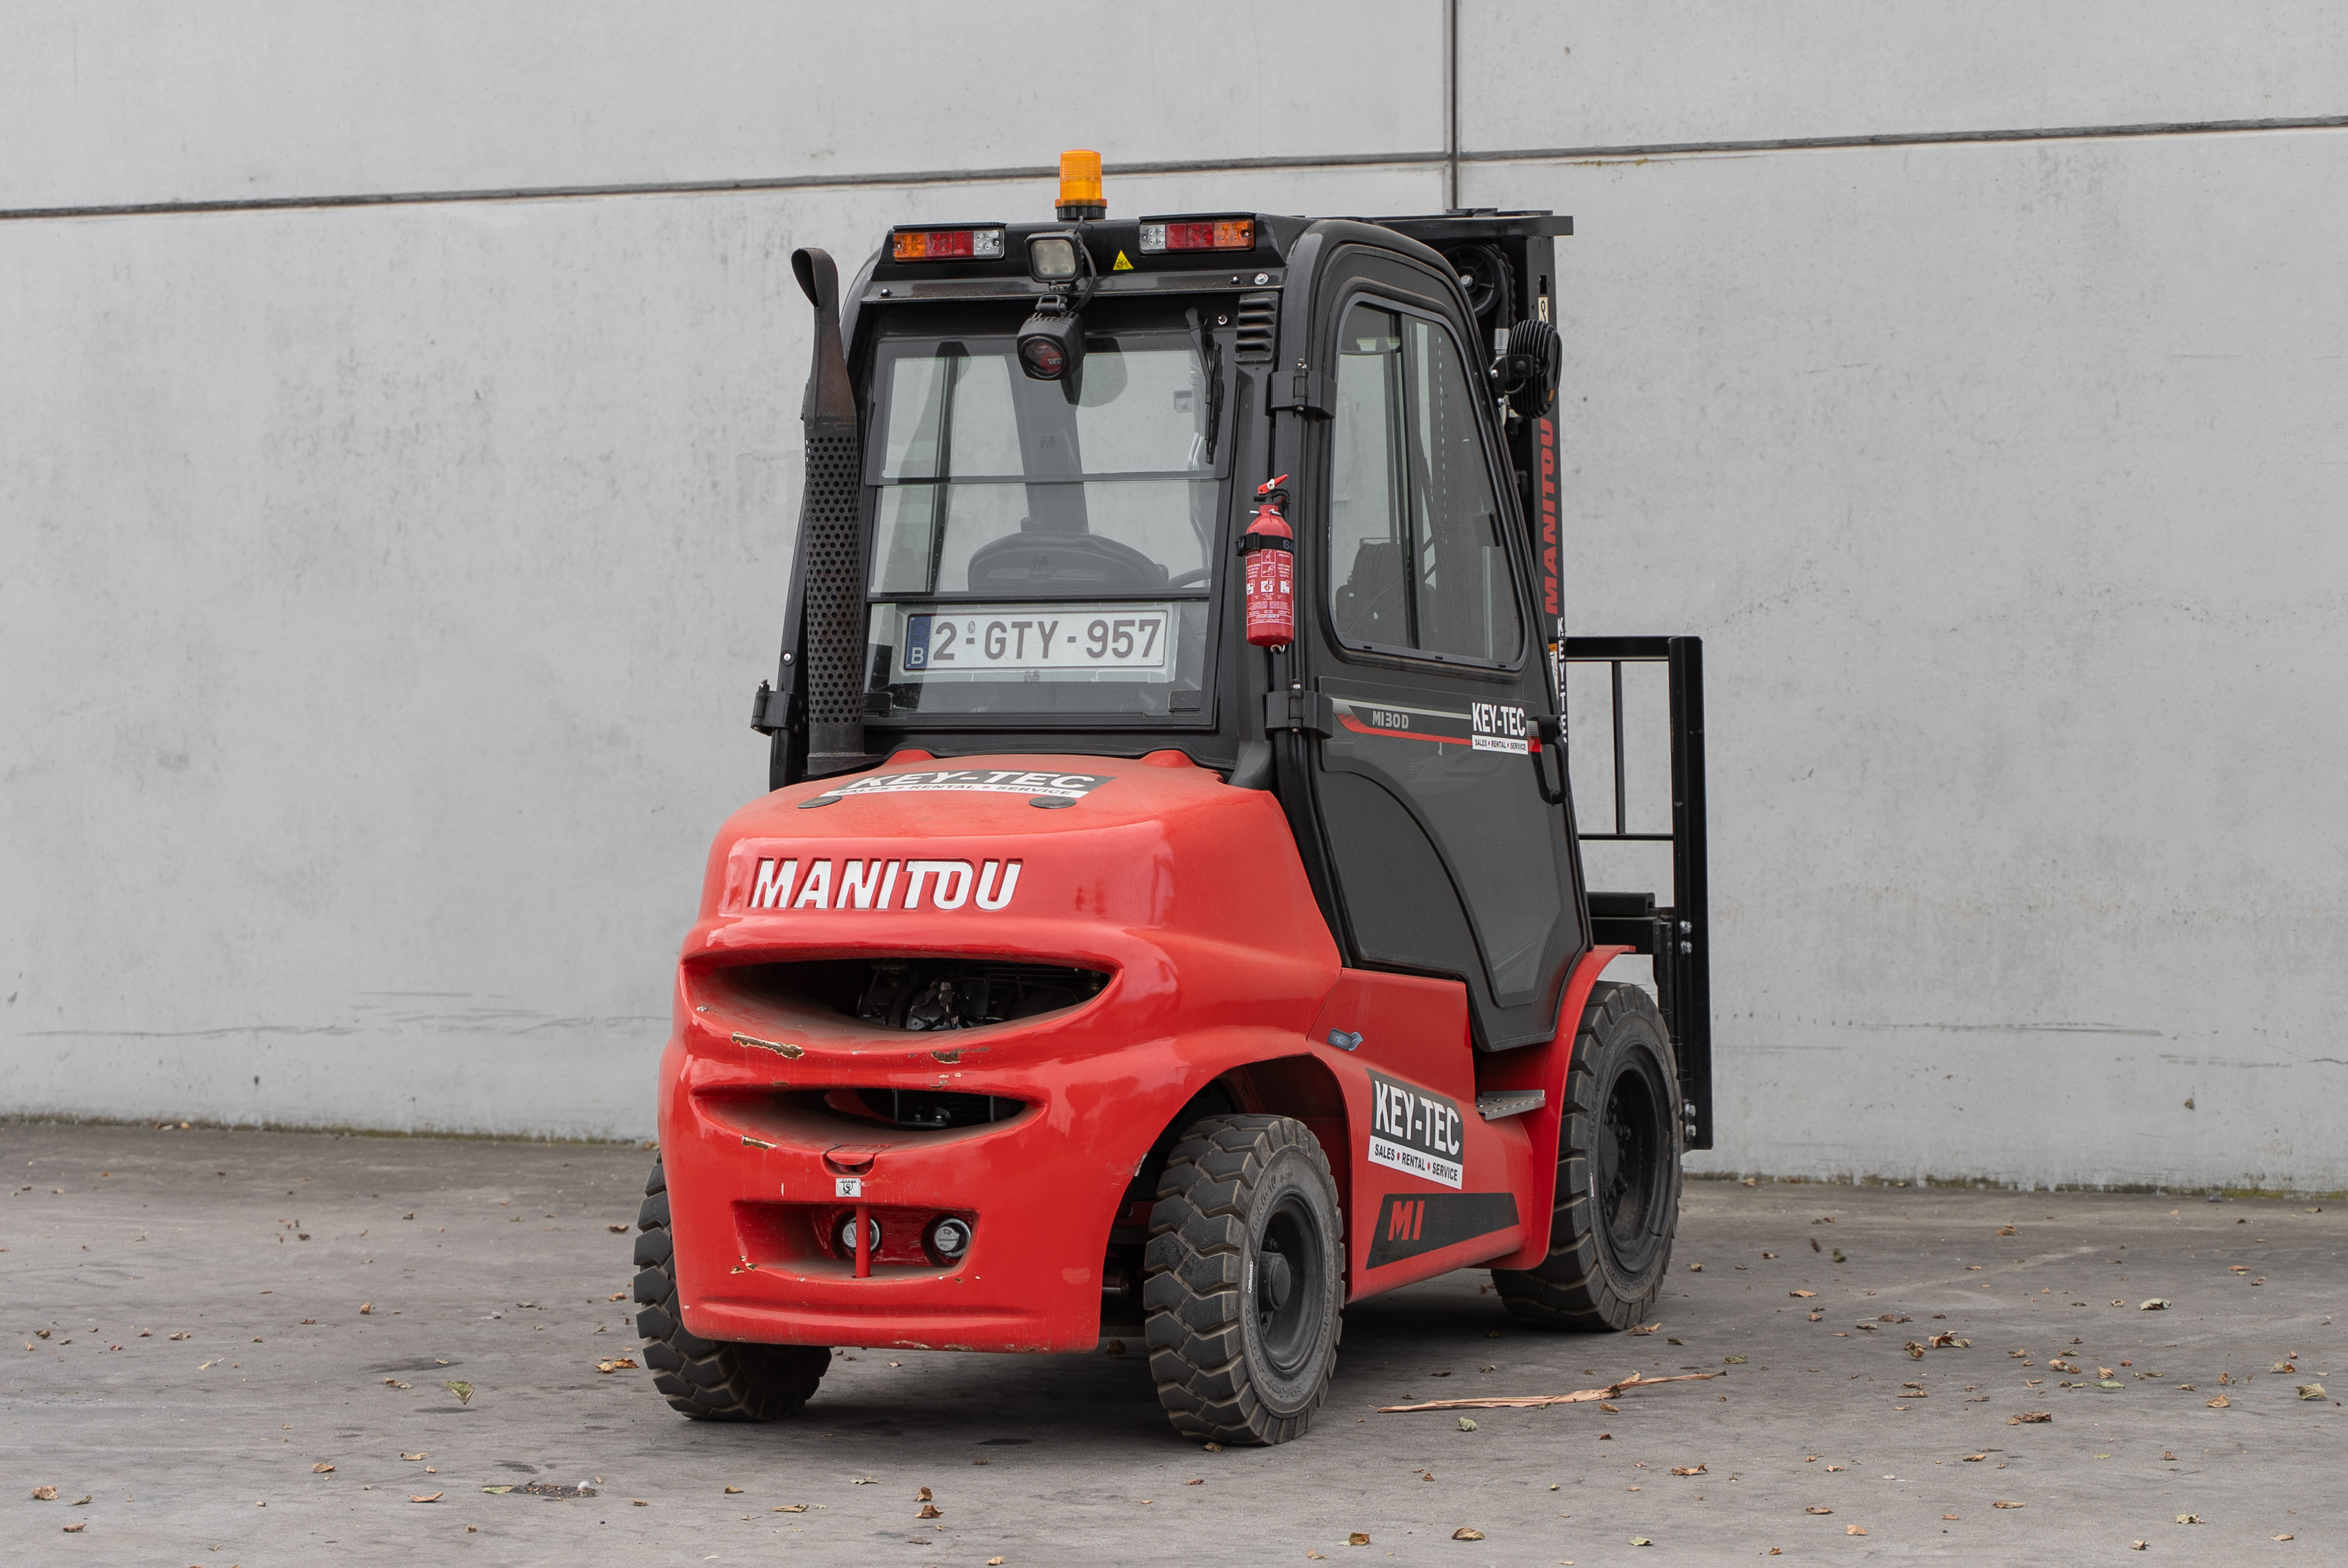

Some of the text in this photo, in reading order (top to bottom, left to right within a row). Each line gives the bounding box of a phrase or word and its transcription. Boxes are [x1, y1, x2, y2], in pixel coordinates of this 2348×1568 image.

[1539, 418, 1558, 614] MANITOU
[912, 647, 924, 665] B
[1557, 617, 1567, 744] KEY-TE
[1472, 702, 1525, 737] KEY-TEC
[1491, 740, 1506, 749] RENTAL
[1510, 742, 1526, 751] SERVICE
[837, 787, 890, 795] SALES
[996, 785, 1073, 795] SERVICE
[847, 771, 1095, 789] KEY-TEC
[749, 858, 1023, 911] MANITOU
[1374, 1080, 1460, 1156] KEY-TEC
[1374, 1144, 1458, 1182] SALES RENTAL SERVICE
